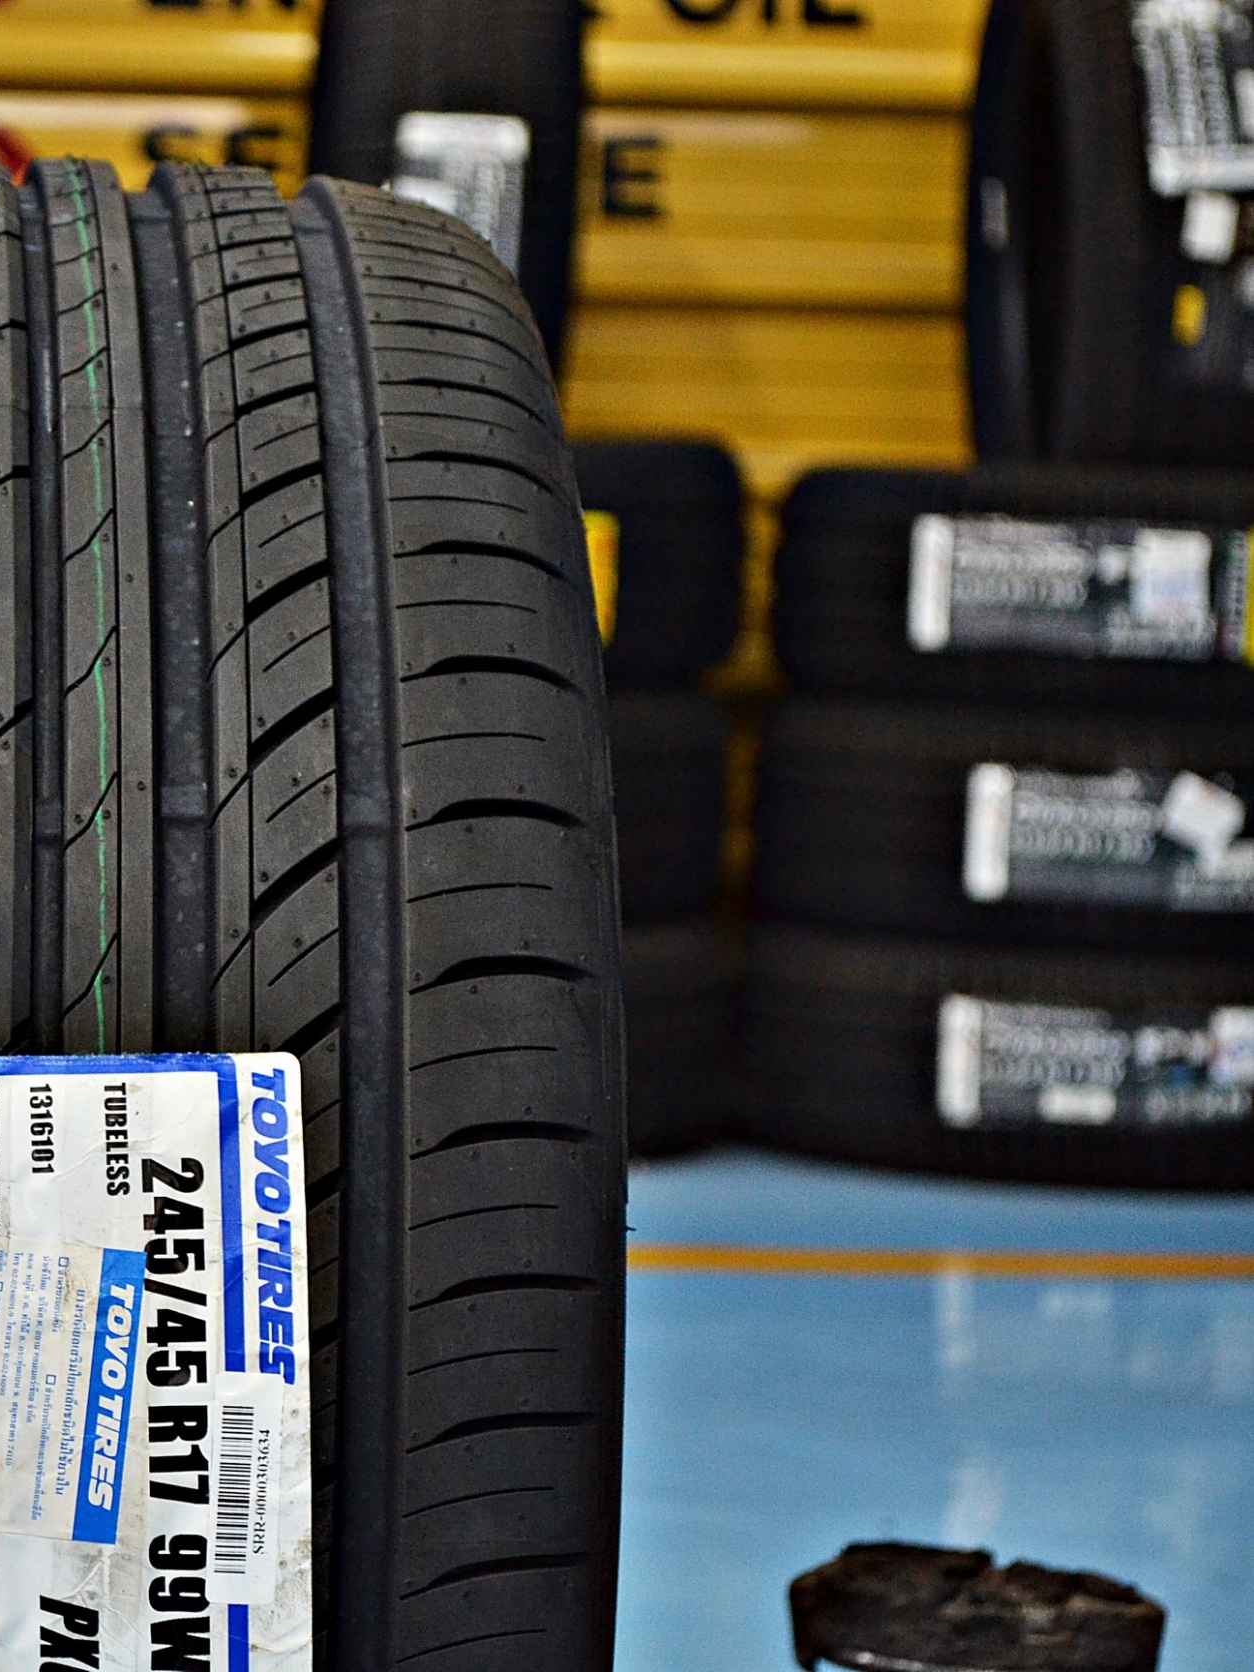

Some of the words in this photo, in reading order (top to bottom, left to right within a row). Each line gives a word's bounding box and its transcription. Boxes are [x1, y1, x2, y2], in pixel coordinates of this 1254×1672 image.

[30, 1083, 54, 1173] 1316101
[104, 1083, 130, 1196] TUBELESS
[251, 1068, 291, 1214] TOYO
[141, 1157, 207, 1387] 245/45
[257, 1219, 295, 1385] TIRES
[99, 1282, 135, 1390] TOYO
[86, 1392, 123, 1510] TIRES
[148, 1405, 210, 1504] R17
[253, 1430, 271, 1554] SRR-0000303634
[149, 1534, 210, 1672] 99W
